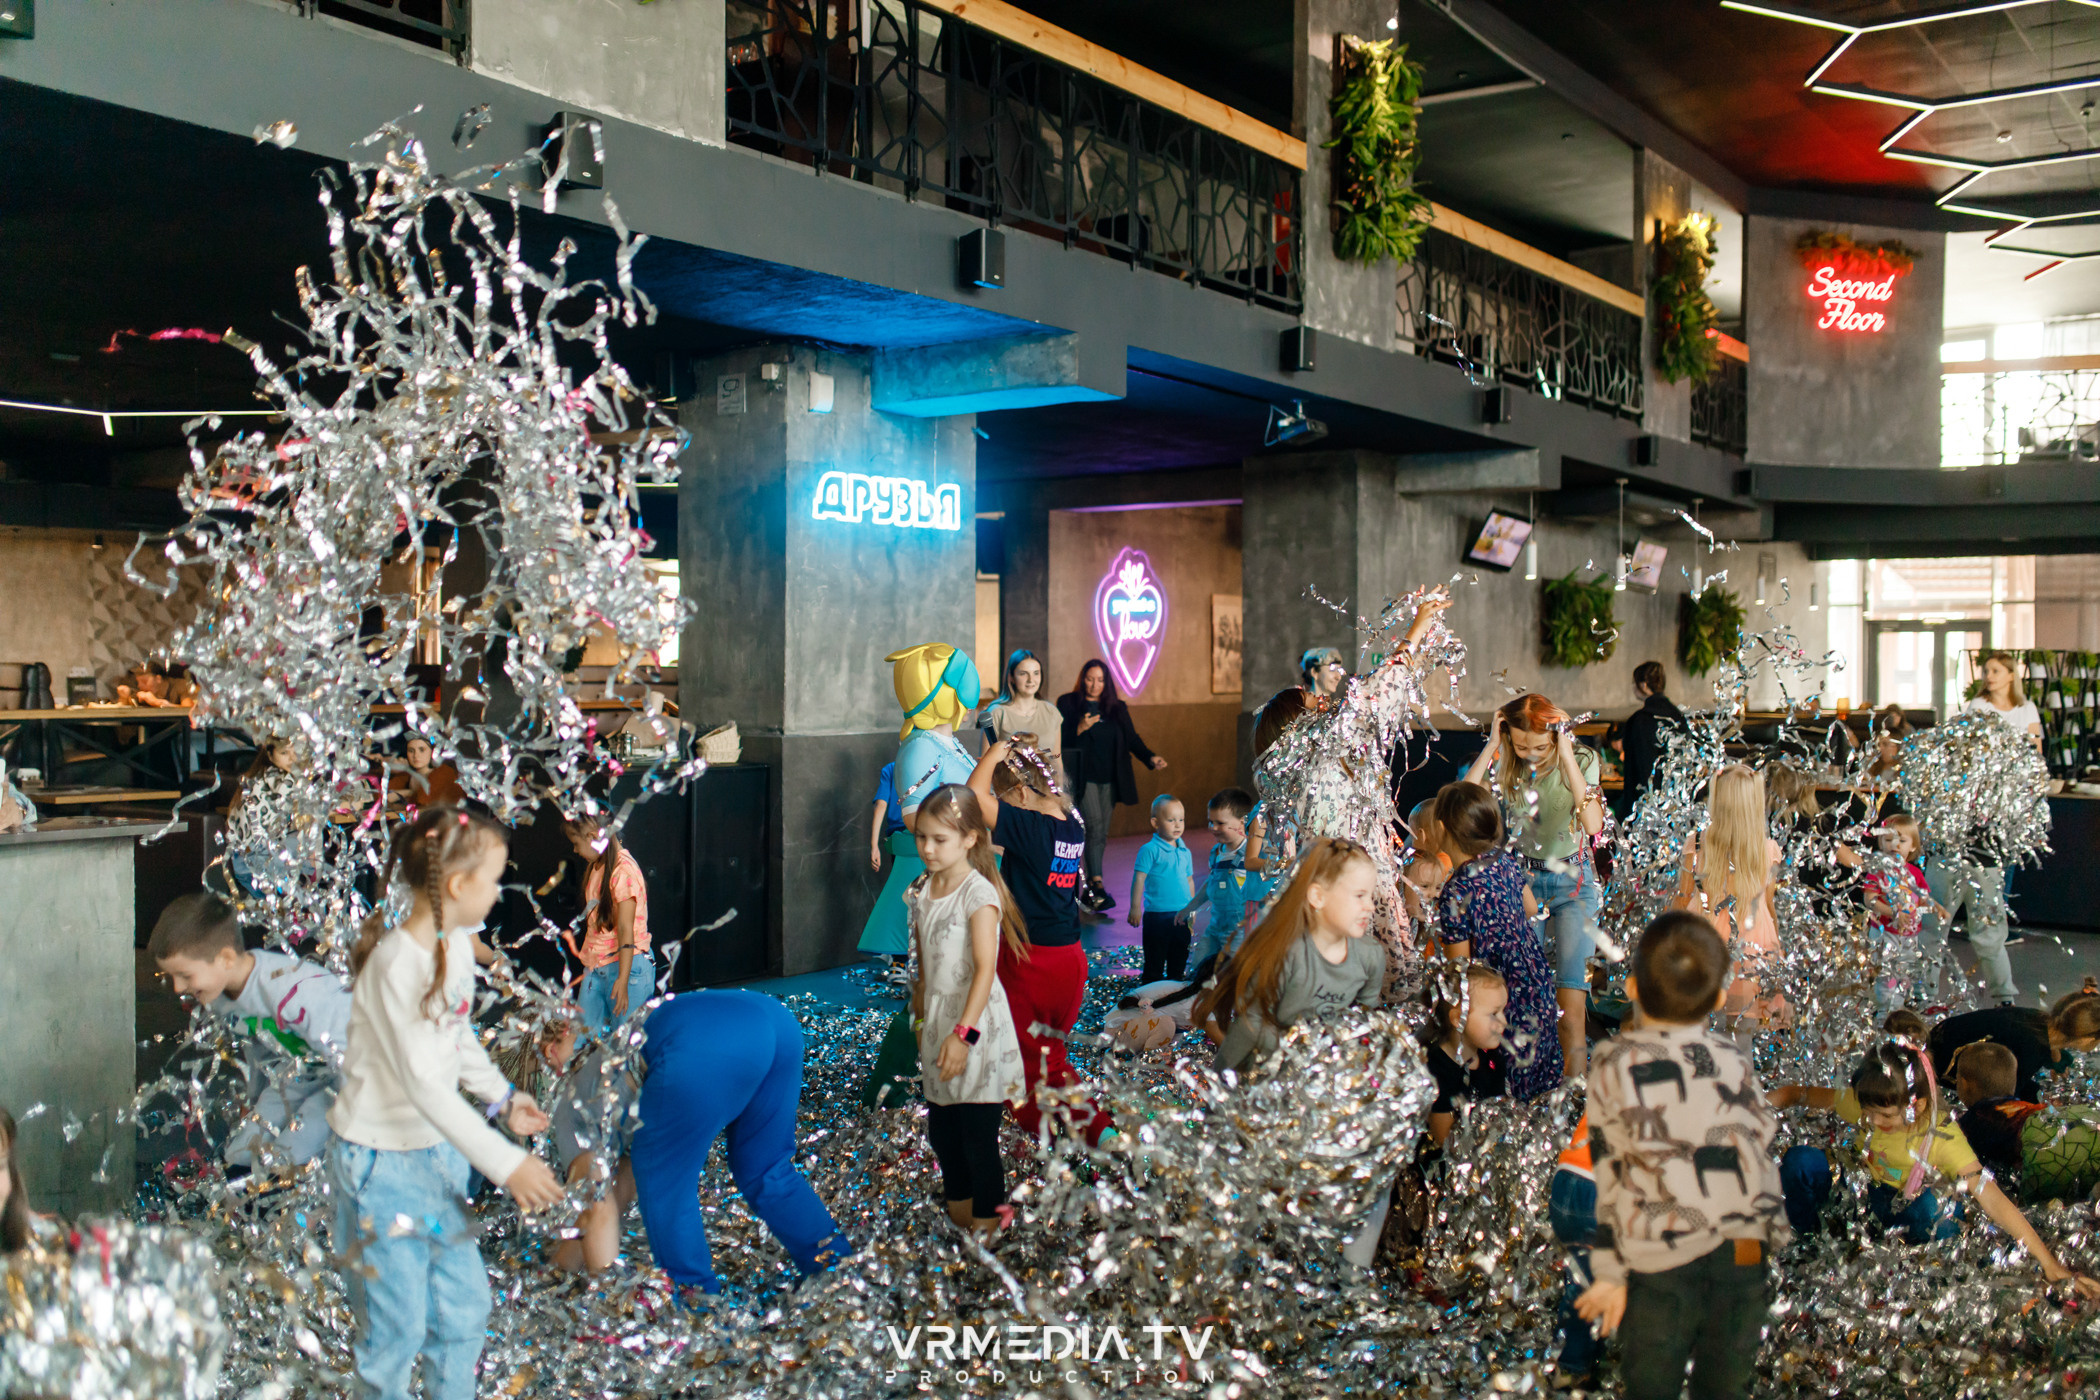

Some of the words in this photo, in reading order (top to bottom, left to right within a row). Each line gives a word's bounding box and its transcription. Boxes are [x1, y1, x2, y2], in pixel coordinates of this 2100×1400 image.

[1808, 266, 1895, 301] Second
[1818, 297, 1885, 332] Floor
[812, 470, 961, 531] ДРУЗЬЯ
